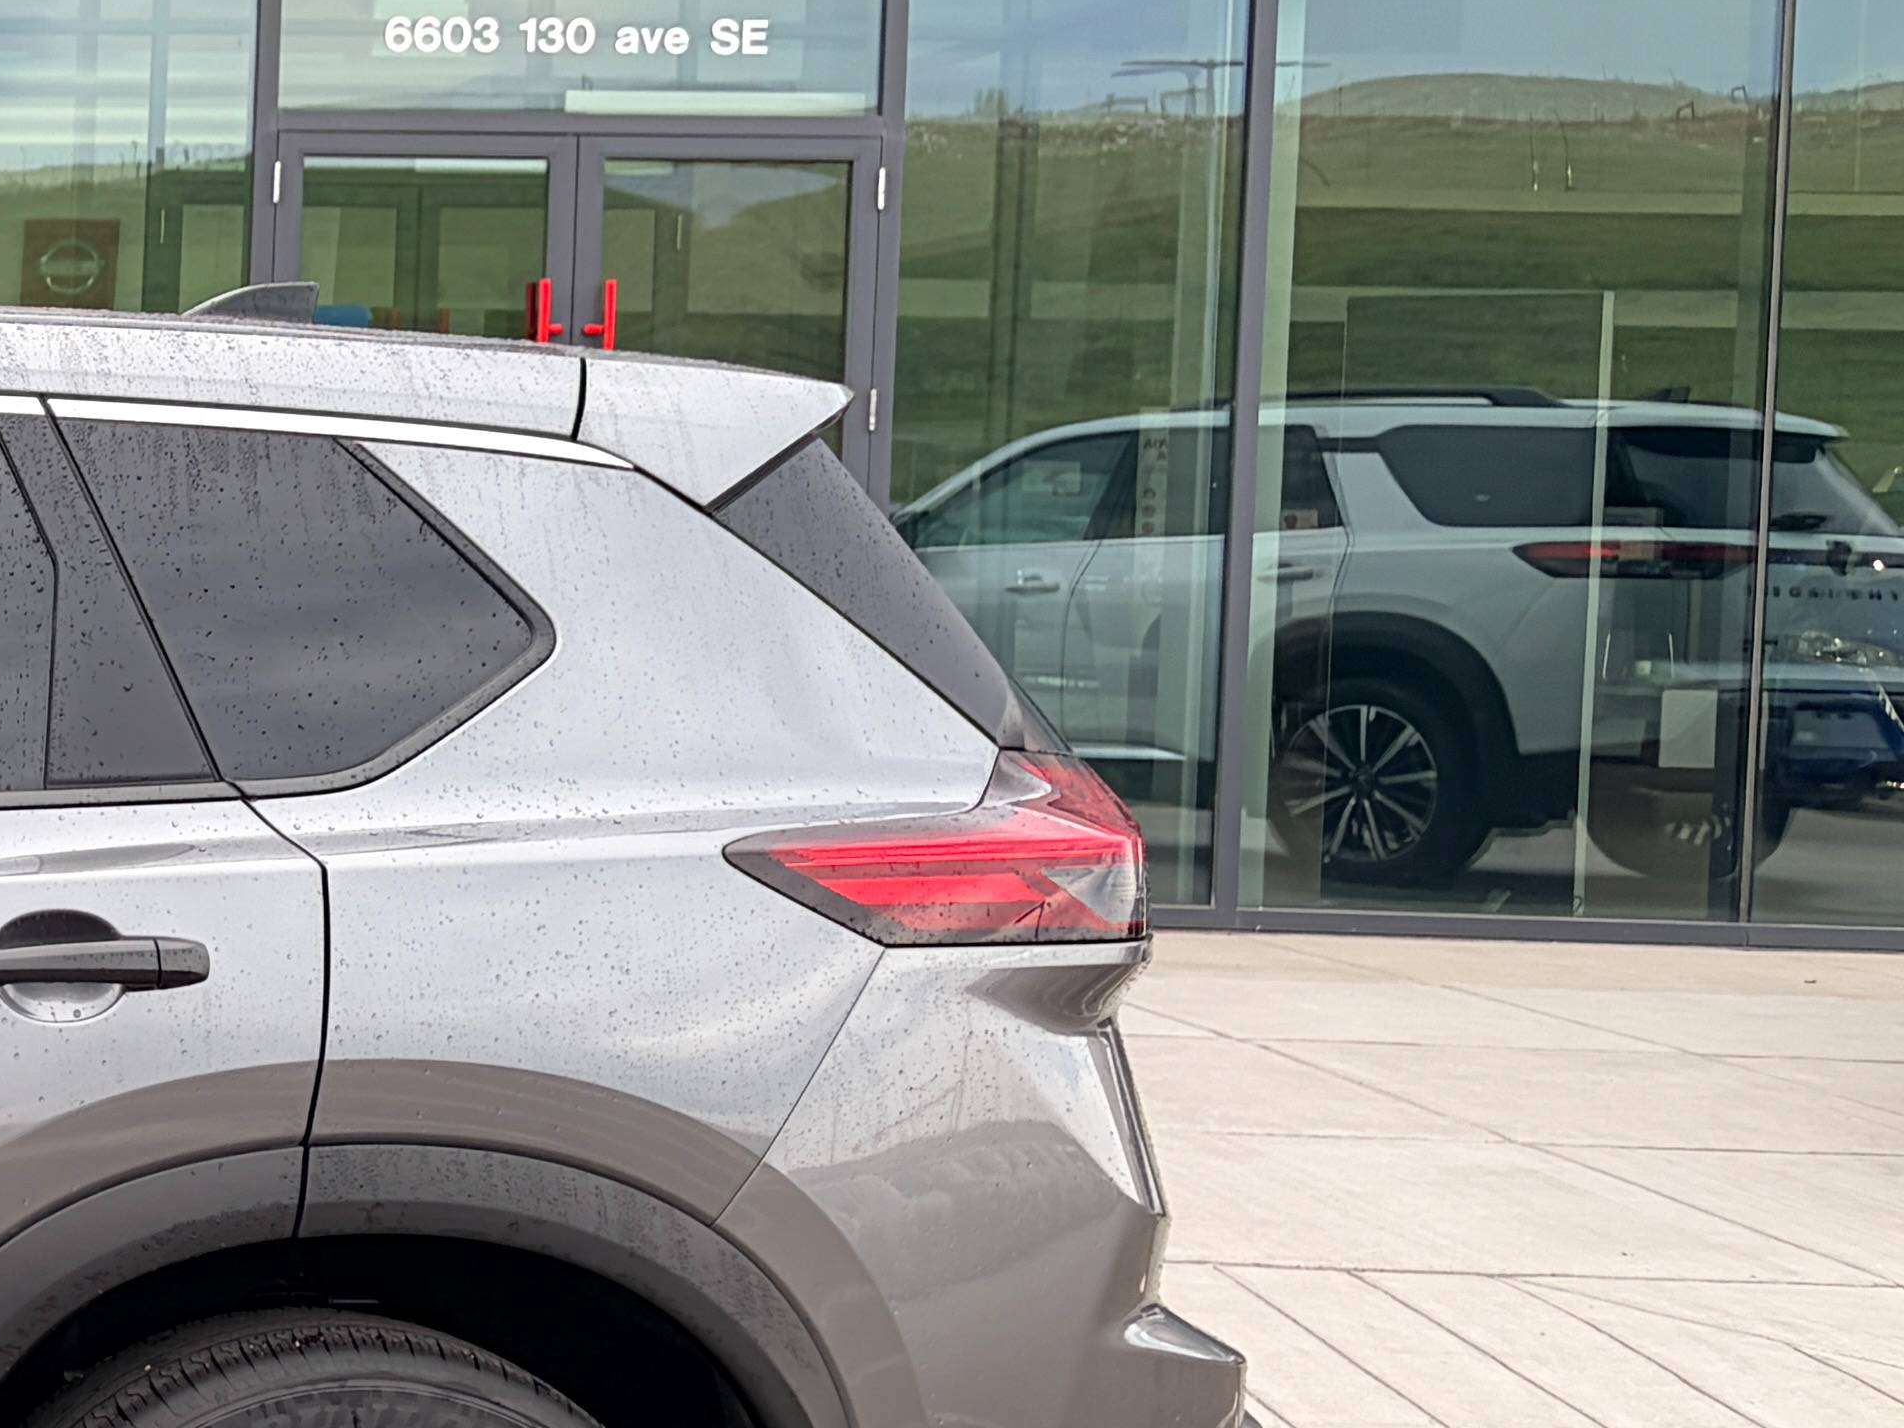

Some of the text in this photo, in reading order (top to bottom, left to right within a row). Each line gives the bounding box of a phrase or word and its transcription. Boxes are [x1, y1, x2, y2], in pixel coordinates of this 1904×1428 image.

[384, 15, 769, 56] 6603 130 ave SE
